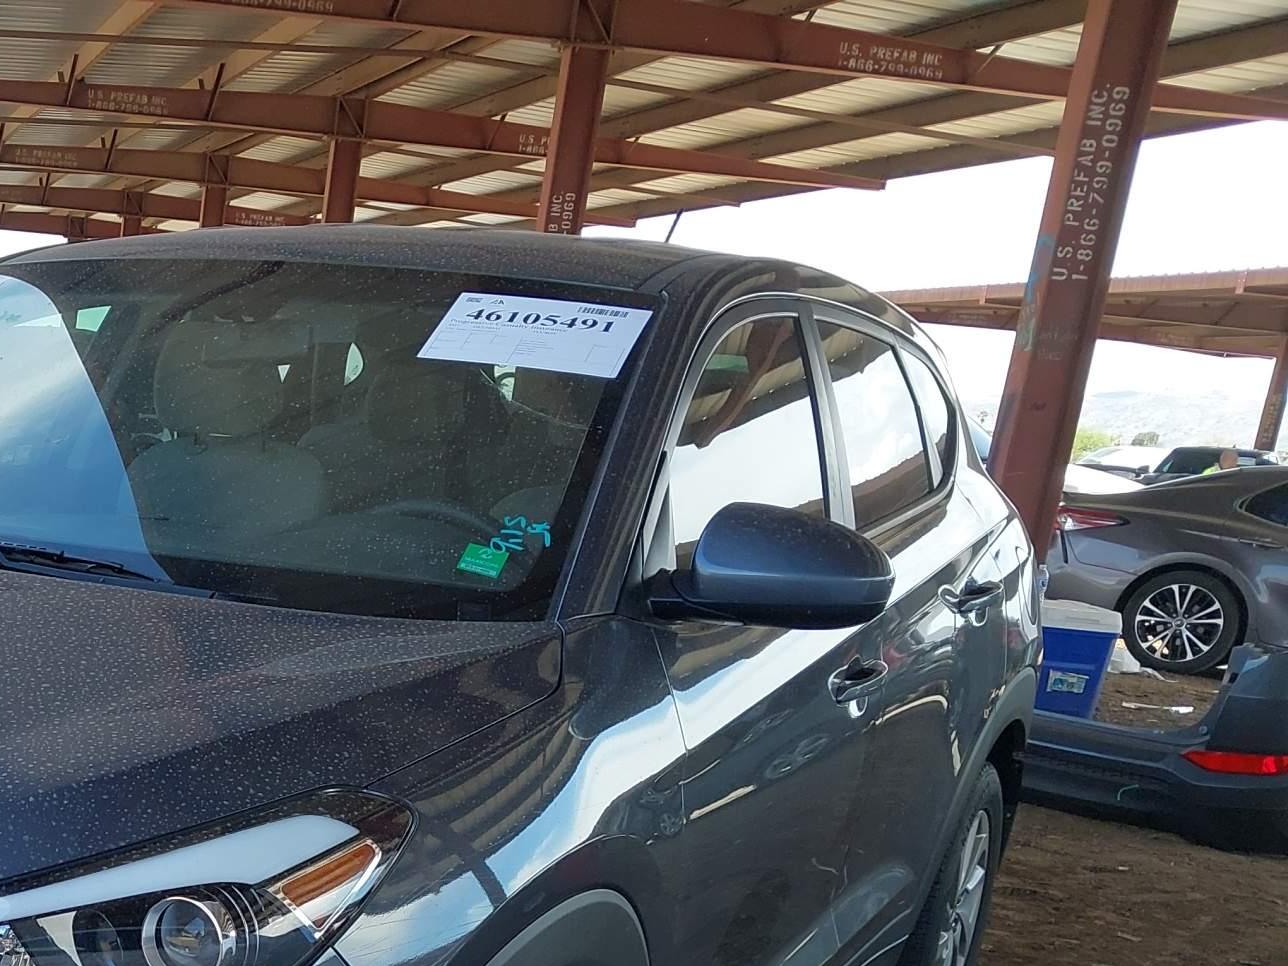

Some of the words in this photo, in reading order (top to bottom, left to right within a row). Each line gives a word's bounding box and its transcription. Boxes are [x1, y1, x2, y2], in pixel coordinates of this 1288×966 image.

[870, 46, 917, 63] PREFAB
[1064, 138, 1097, 226] PREFAB
[1086, 83, 1111, 127] INC.
[1071, 86, 1130, 280] 1-866-799-0969
[466, 307, 615, 333] 46105491
